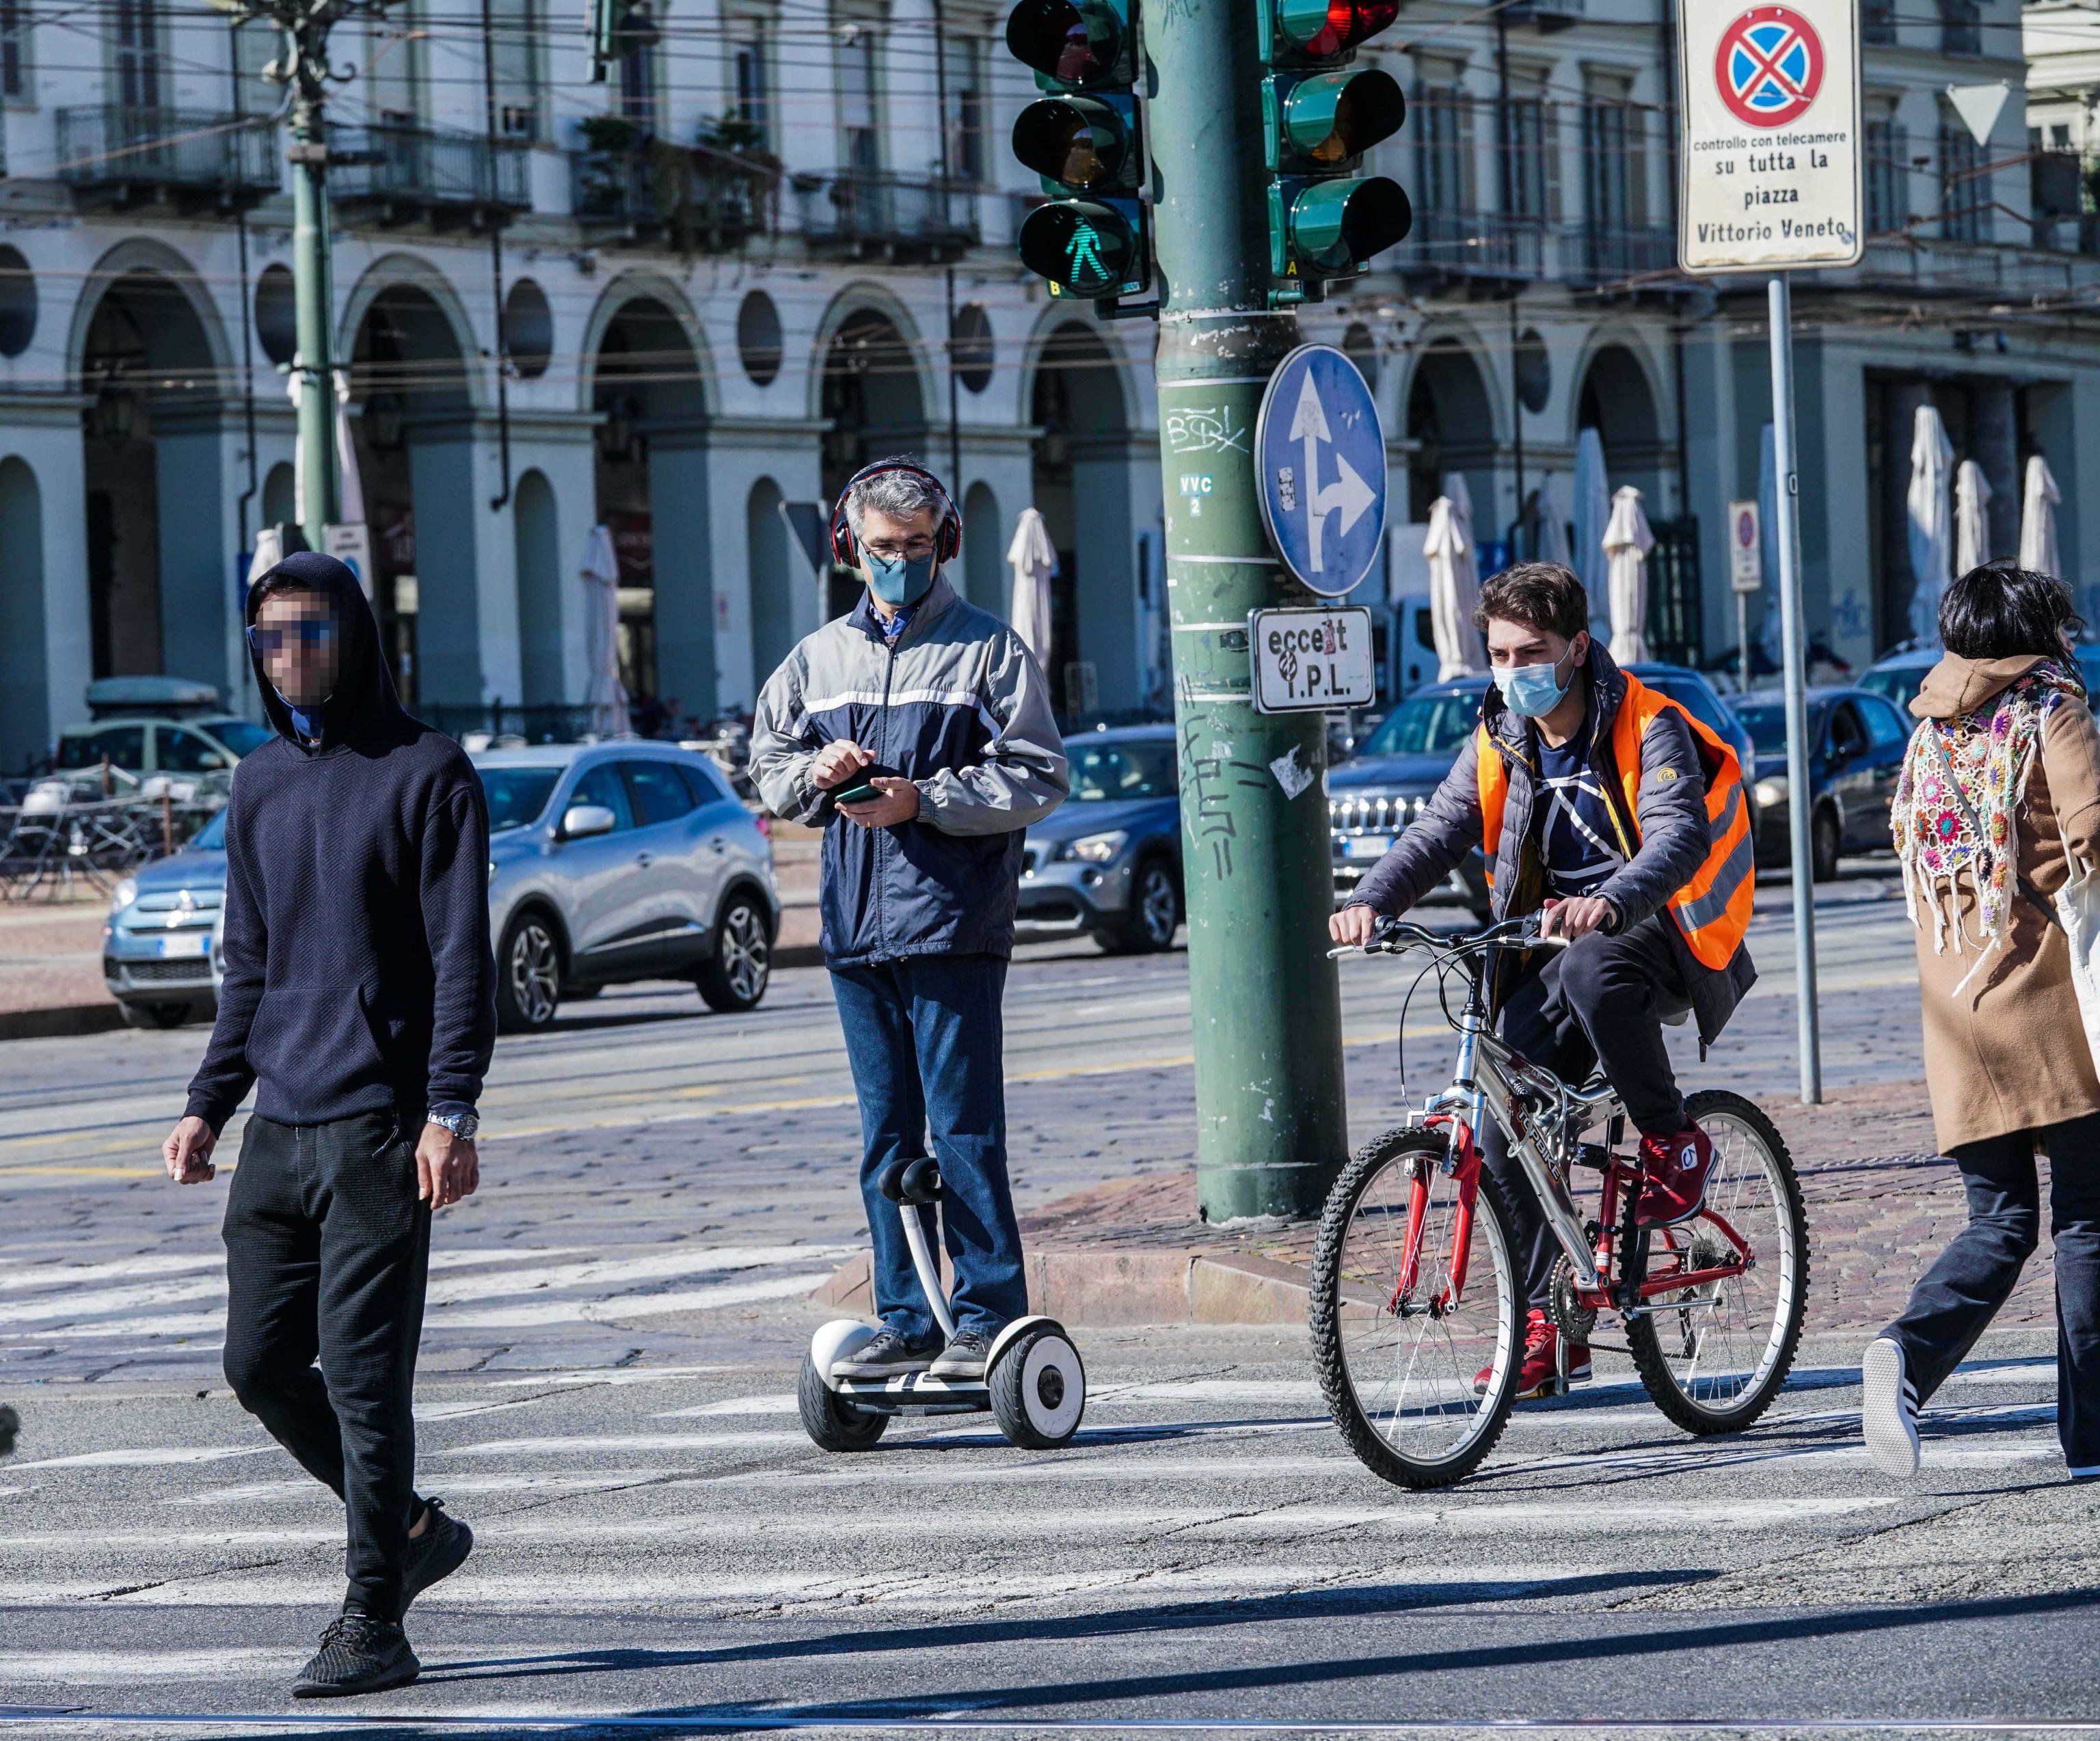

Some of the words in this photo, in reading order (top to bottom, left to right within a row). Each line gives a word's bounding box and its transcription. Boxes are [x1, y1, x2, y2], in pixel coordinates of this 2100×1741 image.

[1694, 136, 1747, 150] controllo
[1751, 137, 1772, 148] con
[1777, 132, 1846, 146] telecamere
[1715, 160, 1734, 175] su
[1749, 152, 1796, 172] tutta
[1811, 149, 1828, 168] la
[1745, 186, 1799, 210] piazza
[1697, 221, 1772, 243] Vittorio
[1781, 217, 1845, 238] Veneto
[1287, 260, 1297, 275] A
[1180, 476, 1213, 493] VVC
[1191, 498, 1200, 515] 2
[1268, 618, 1348, 656] eccet
